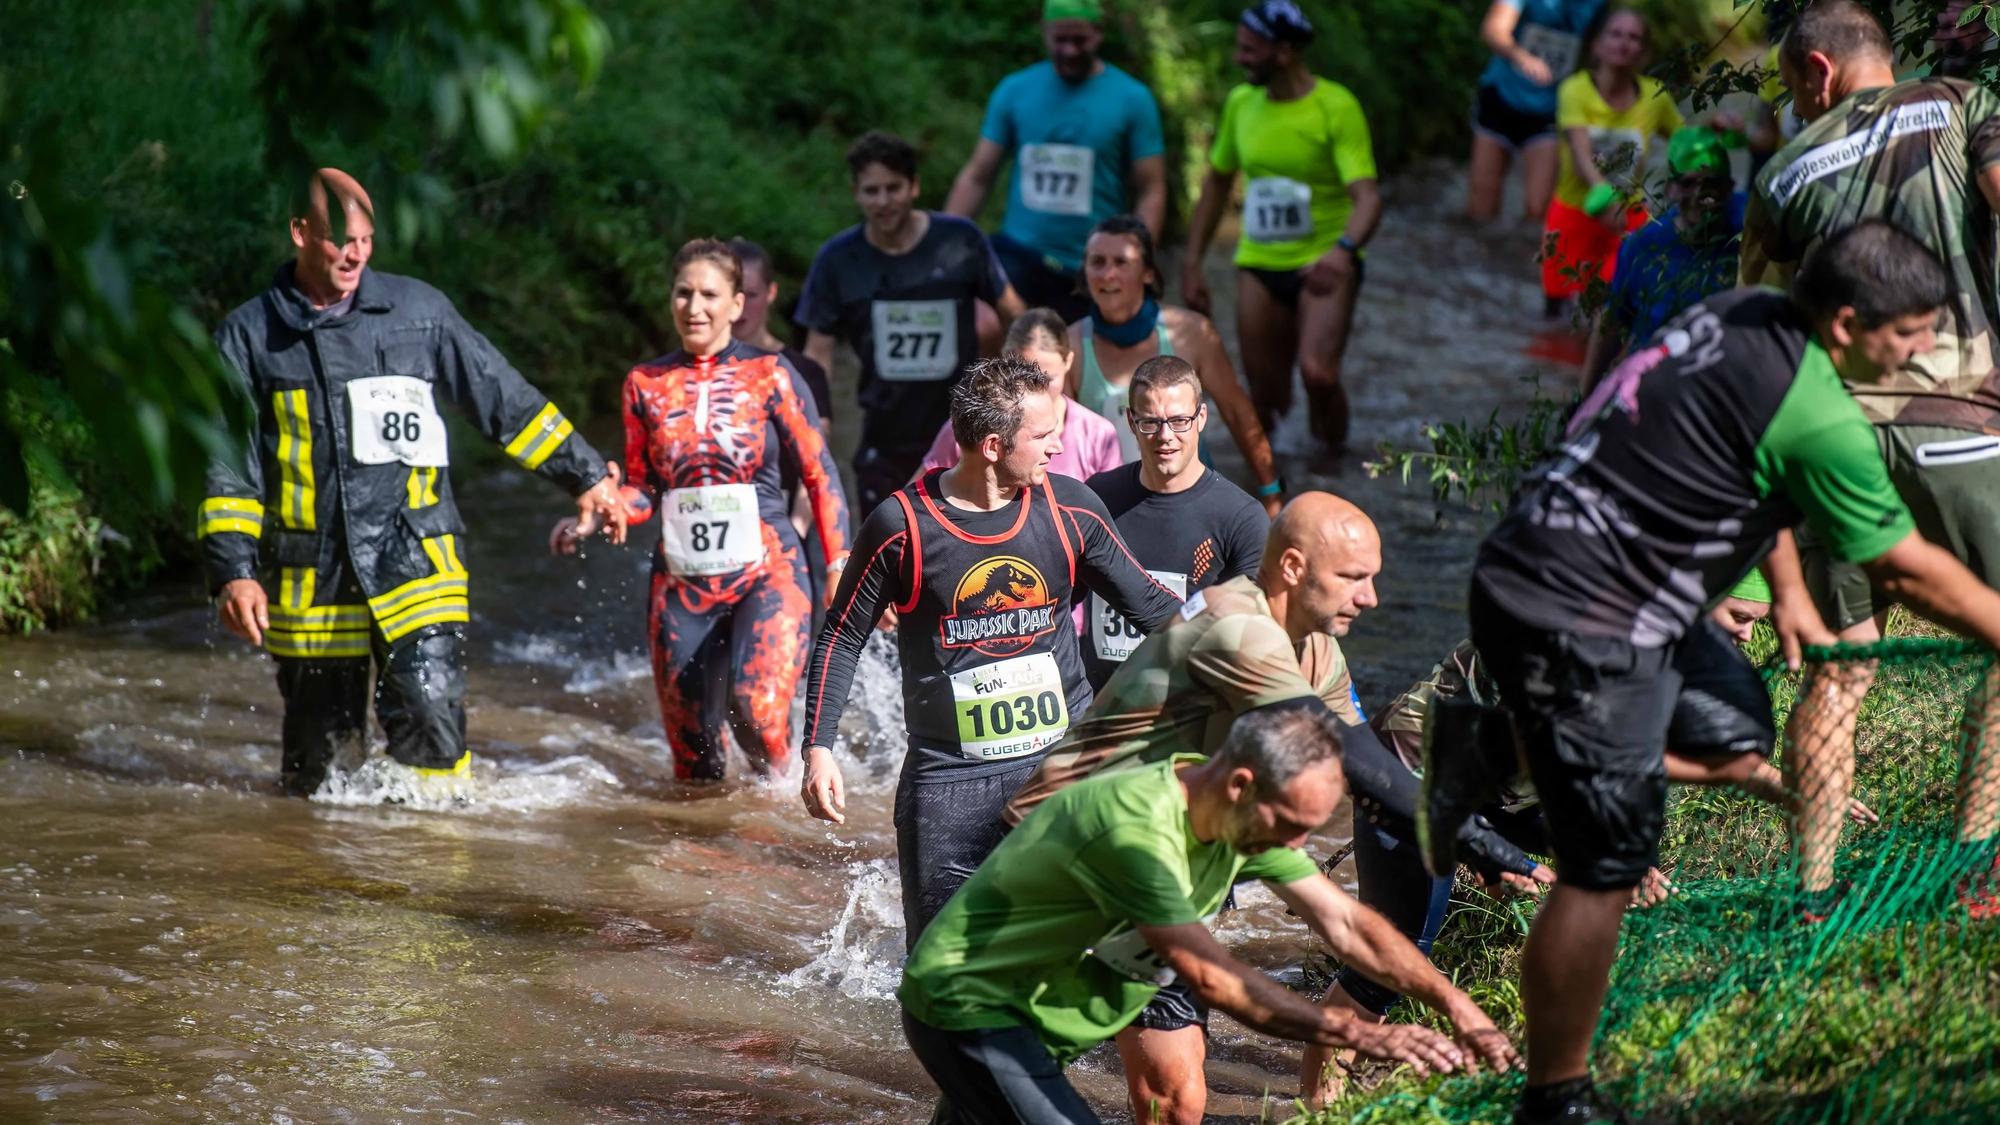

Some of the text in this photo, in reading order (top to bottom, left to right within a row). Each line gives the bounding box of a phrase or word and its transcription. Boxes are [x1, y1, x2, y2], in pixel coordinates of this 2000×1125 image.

[1034, 170, 1078, 196] 177
[888, 332, 942, 360] 277
[382, 411, 420, 442] 86
[691, 521, 729, 552] 87
[946, 606, 1054, 645] JURASSIC PARK
[966, 691, 1060, 737] 1030
